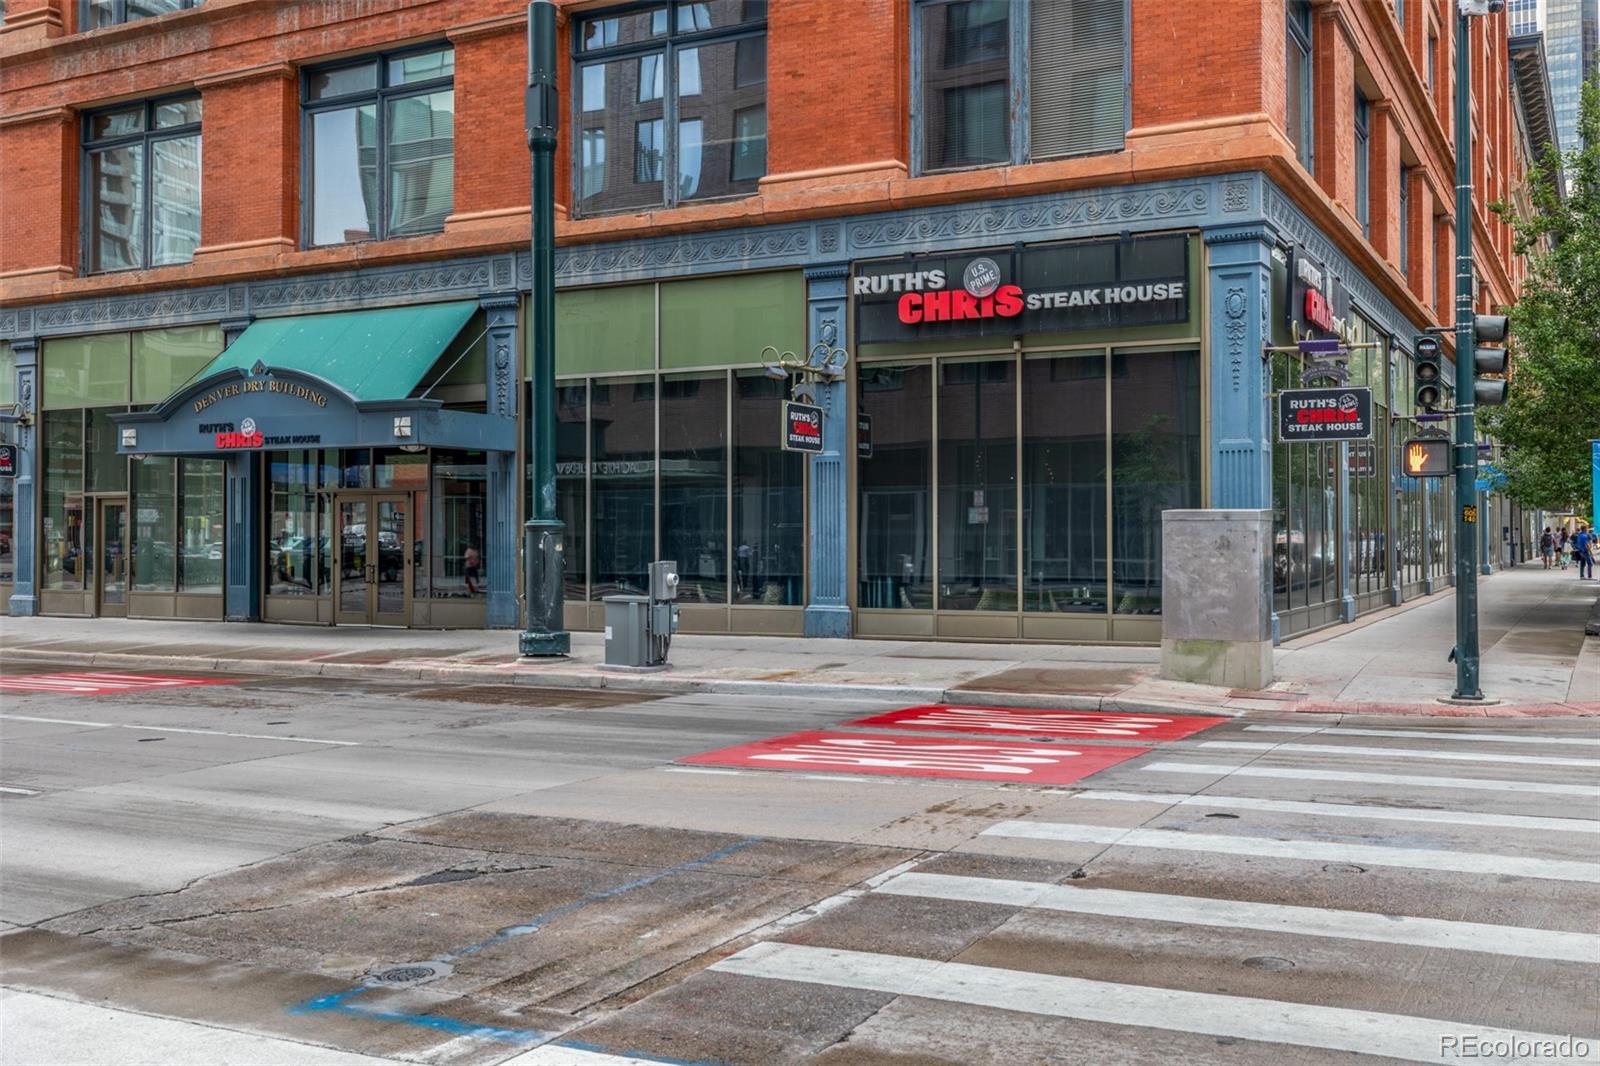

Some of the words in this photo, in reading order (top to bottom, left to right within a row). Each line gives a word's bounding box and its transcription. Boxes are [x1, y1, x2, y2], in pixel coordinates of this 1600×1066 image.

[854, 269, 946, 295] RUTH'S
[970, 270, 996, 291] PRIME
[898, 285, 1024, 324] CHRIS
[1027, 289, 1101, 310] STEAK
[1104, 283, 1184, 304] HOUSE
[194, 384, 240, 413] DENVER
[243, 380, 266, 393] DRY
[268, 381, 328, 408] BUILDING
[1290, 398, 1337, 409] RUTH'S
[199, 423, 234, 434] RUTH'S
[1288, 424, 1323, 432] STEAK
[1326, 422, 1363, 431] HOUSE
[215, 431, 264, 449] CHRIS
[264, 436, 291, 445] STEAK
[292, 435, 321, 444] HOUSE
[748, 739, 1083, 775] BUS
